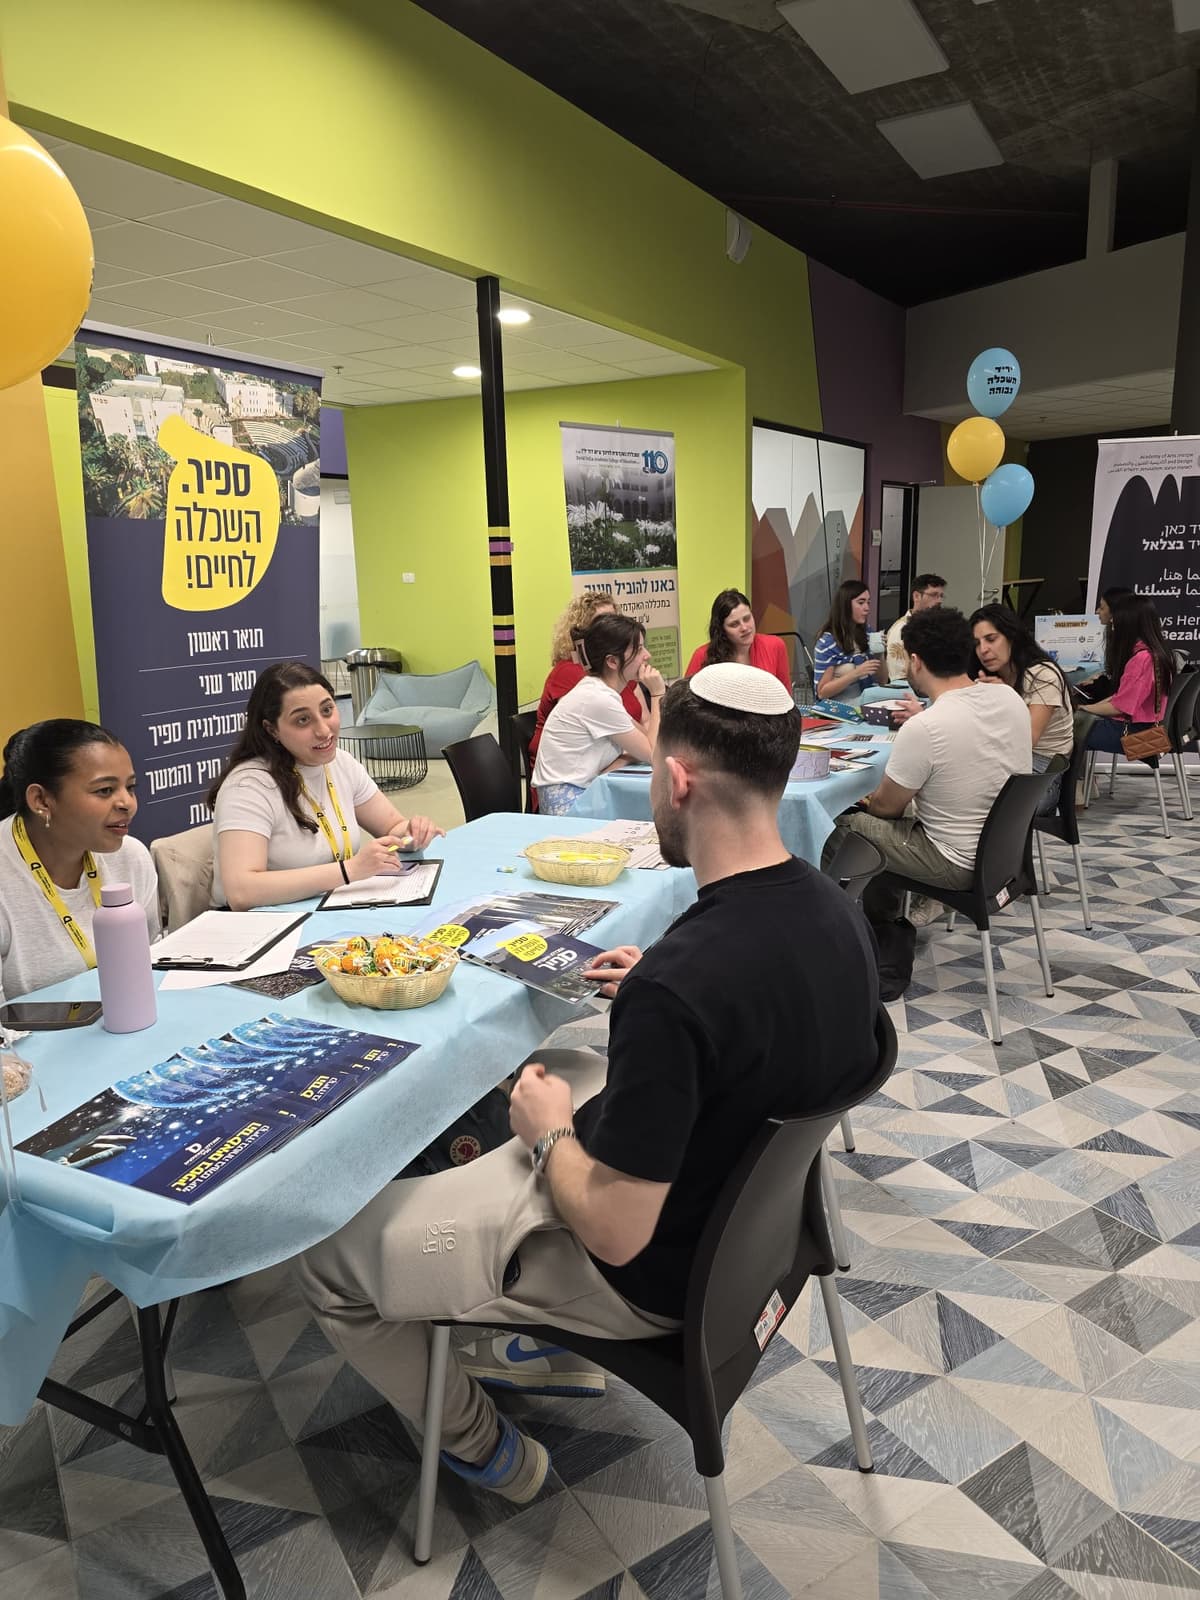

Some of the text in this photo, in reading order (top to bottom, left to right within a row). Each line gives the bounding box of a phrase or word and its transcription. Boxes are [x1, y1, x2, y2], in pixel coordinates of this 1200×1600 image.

[987, 375, 1017, 385] השכלה
[989, 386, 1013, 395] גבוהה
[182, 458, 251, 498] ספיר.
[174, 502, 262, 544] השכלה
[1142, 539, 1184, 551] בצלאל
[186, 550, 256, 589] לחיים!
[614, 578, 648, 596] להוביל
[651, 579, 675, 592] באנו
[620, 602, 645, 612] האקדמי
[187, 628, 264, 657] תואר ראשון
[199, 670, 257, 696] תואר שני
[148, 722, 182, 746] ספיר
[145, 758, 221, 795] חוץ והמשך
